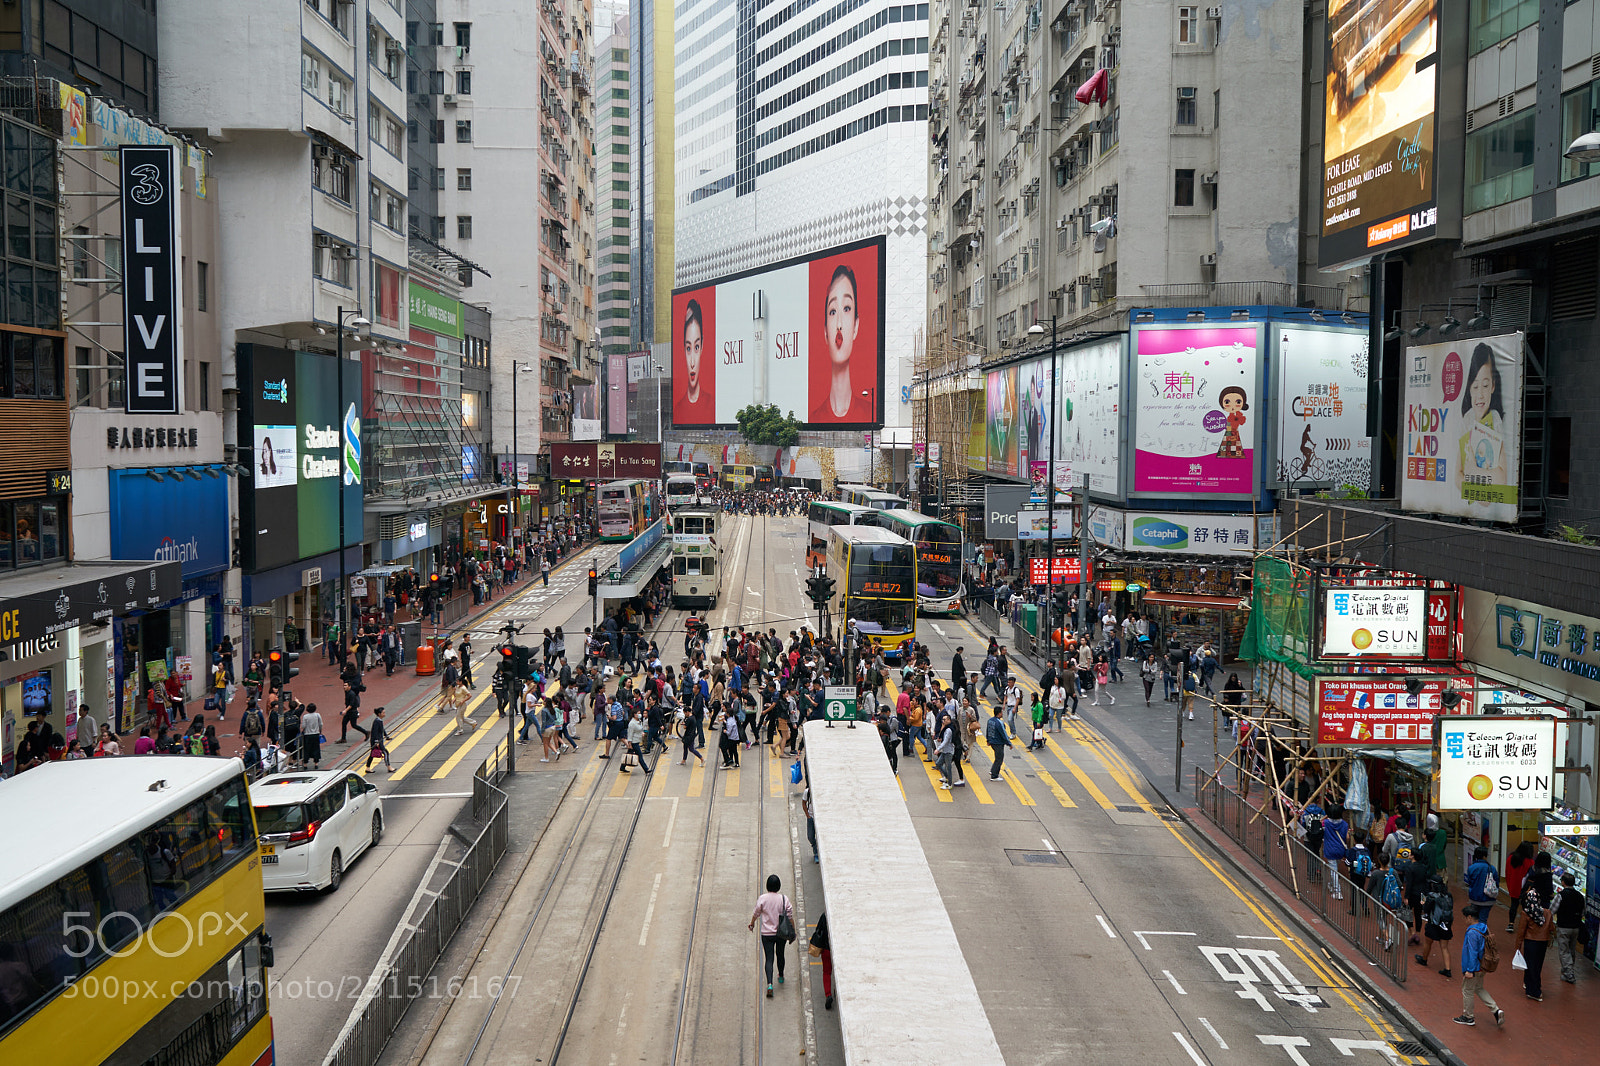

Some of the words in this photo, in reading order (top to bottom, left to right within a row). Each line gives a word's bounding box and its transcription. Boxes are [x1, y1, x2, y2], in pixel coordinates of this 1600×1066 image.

[1327, 164, 1340, 181] FOR
[1342, 154, 1360, 175] LEASE
[1330, 181, 1346, 196] CASTLE
[1363, 169, 1374, 182] MID
[1375, 161, 1392, 178] LEVELS
[134, 218, 166, 397] LIVE
[775, 331, 799, 359] SK-II
[723, 340, 743, 365] SK-II
[264, 380, 281, 390] Standard
[262, 390, 281, 401] Chartered
[1303, 407, 1332, 421] PLACE
[1408, 433, 1439, 456] LAND
[562, 455, 590, 467] 余仁生
[620, 457, 627, 465] Eu
[629, 457, 640, 465] Yan
[641, 457, 656, 467] Sang
[61, 475, 71, 489] 24
[991, 511, 1017, 524] Pric
[1142, 528, 1178, 540] Cetaphil
[1194, 527, 1250, 545] 舒特膚
[154, 535, 199, 563] citibank
[890, 583, 901, 593] 72
[1351, 593, 1381, 602] Telecom
[1383, 593, 1409, 602] Digital
[1351, 602, 1409, 615] 電訊數碼
[1377, 630, 1418, 642] SUN
[1324, 682, 1340, 690] Toko
[1341, 682, 1349, 690] ini
[1350, 682, 1372, 690] khusus
[1373, 682, 1387, 690] buat
[1322, 712, 1332, 720] Ang
[1333, 712, 1346, 720] shop
[1410, 713, 1422, 721] mga
[1466, 732, 1503, 741] Telecom
[1506, 731, 1537, 742] Digital
[1467, 743, 1537, 758] 電訊數碼
[1498, 775, 1548, 791] SUN
